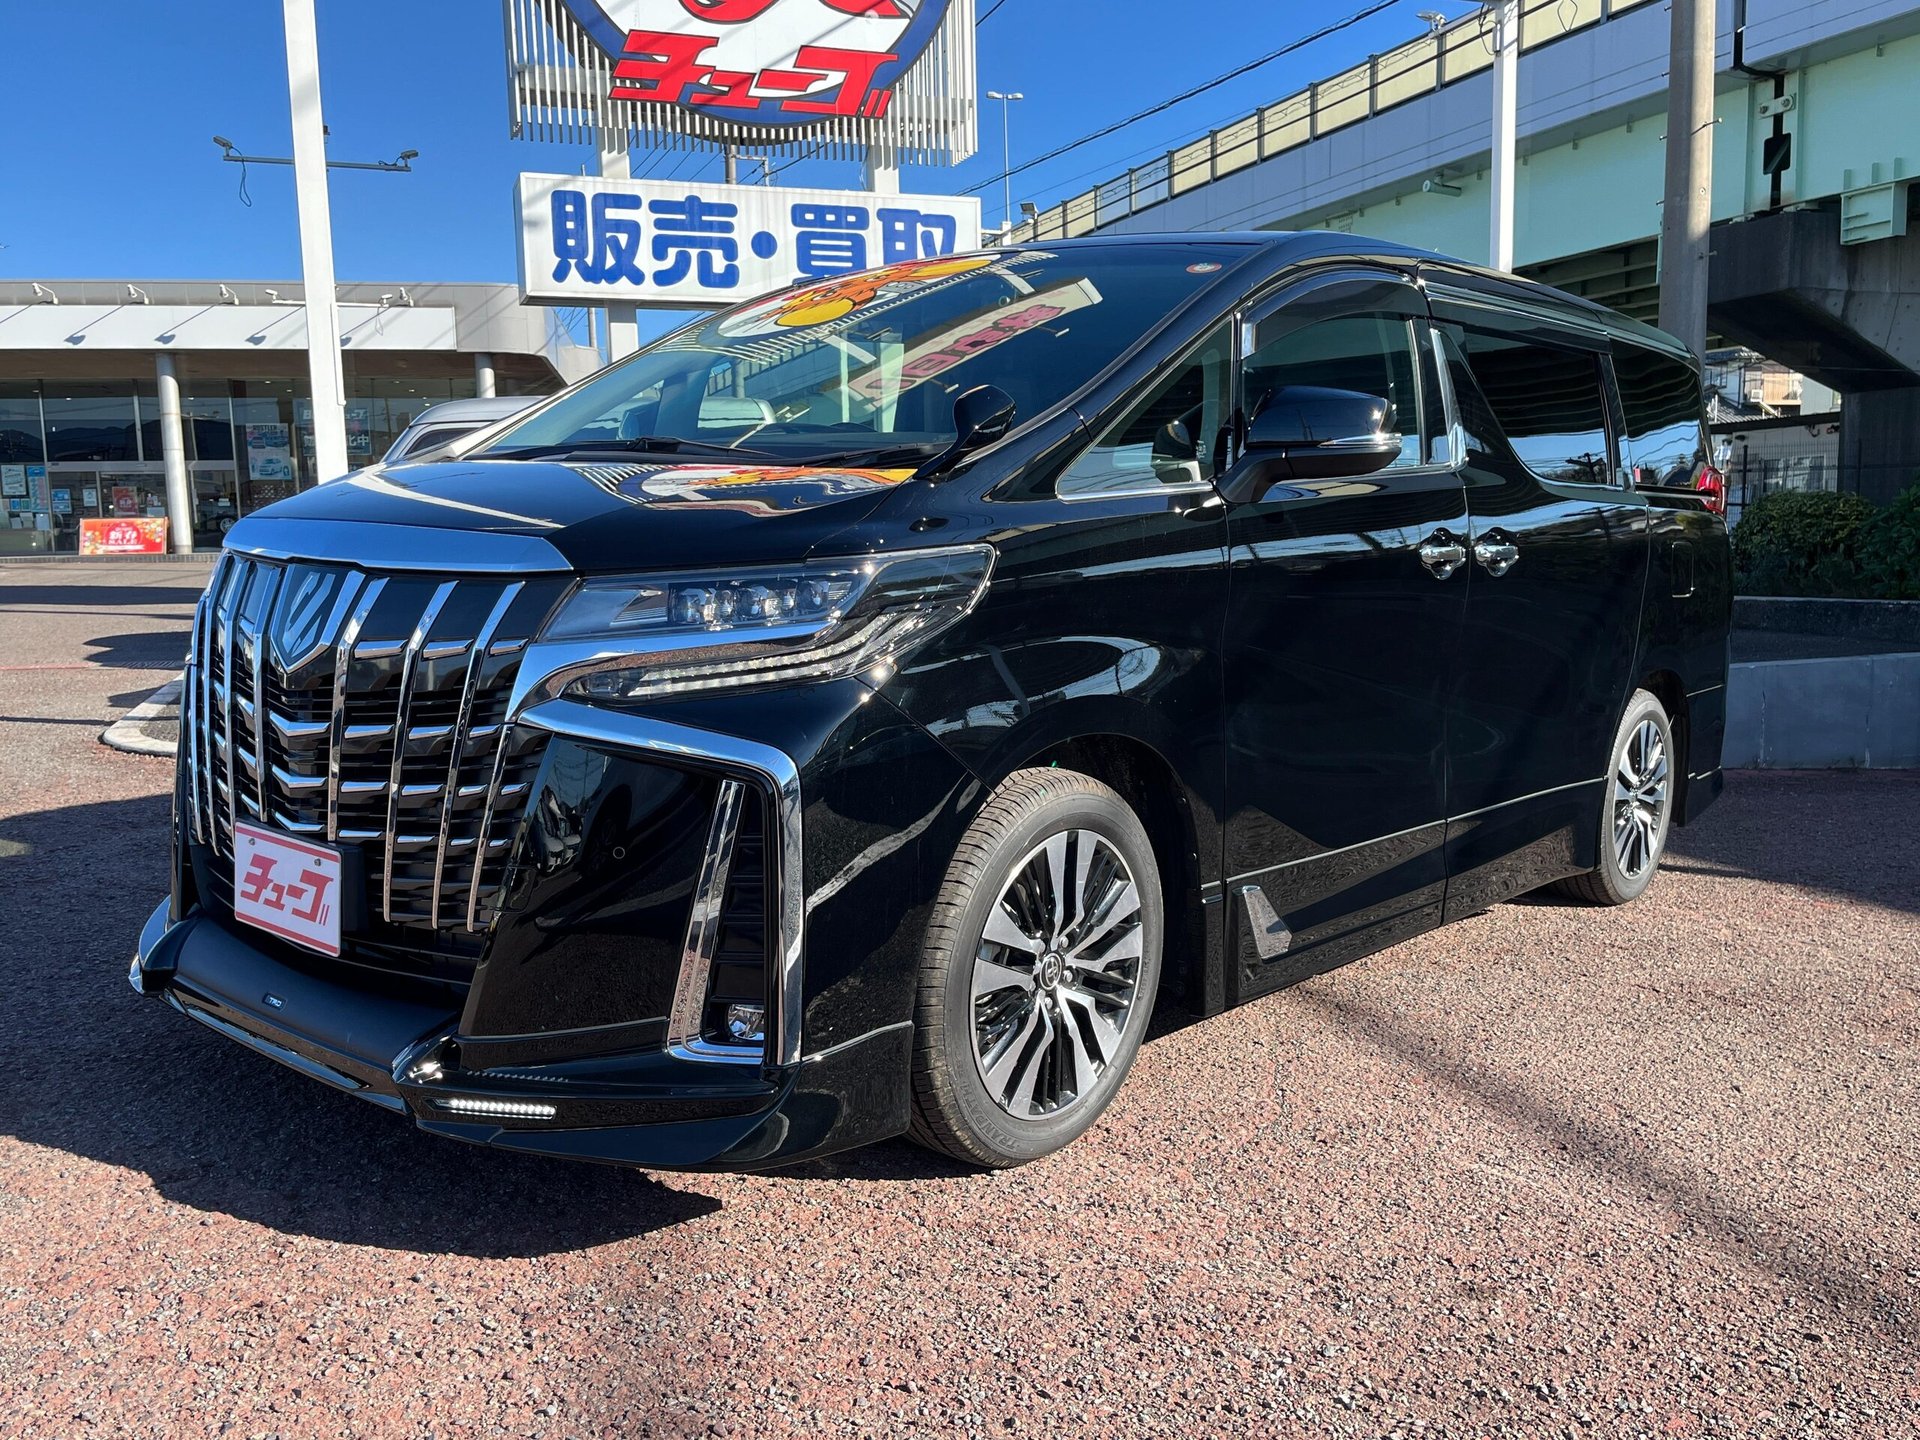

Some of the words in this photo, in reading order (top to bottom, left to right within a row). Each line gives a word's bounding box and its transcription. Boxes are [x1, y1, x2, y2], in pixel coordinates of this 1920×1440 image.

[550, 189, 957, 287] 販売・買取
